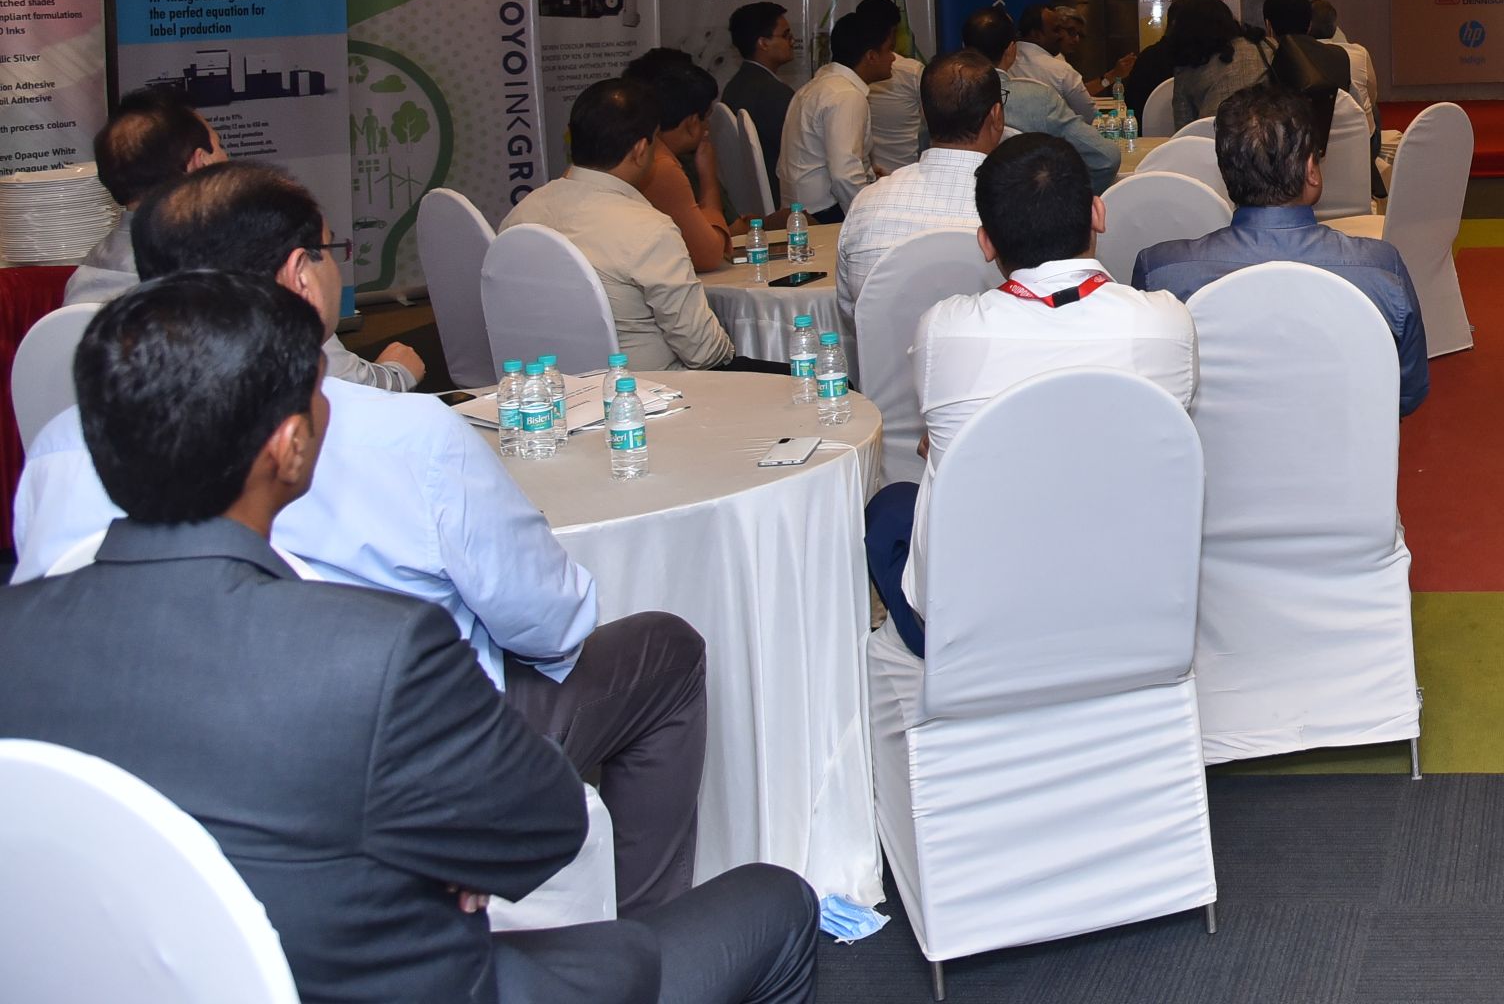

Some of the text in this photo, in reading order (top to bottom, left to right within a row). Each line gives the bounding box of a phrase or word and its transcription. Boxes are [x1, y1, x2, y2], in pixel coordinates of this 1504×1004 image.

[32, 10, 83, 20] formulations
[149, 3, 266, 22] the perfect equation for
[6, 27, 26, 35] Inks
[150, 21, 232, 38] label production
[13, 54, 41, 63] Silver
[15, 80, 56, 90] Adhesive
[11, 95, 52, 105] Adhesive
[10, 123, 45, 134] process
[46, 120, 77, 130] colours
[14, 150, 50, 161] Opaque
[52, 147, 77, 156] White
[526, 414, 550, 425] Bisleri
